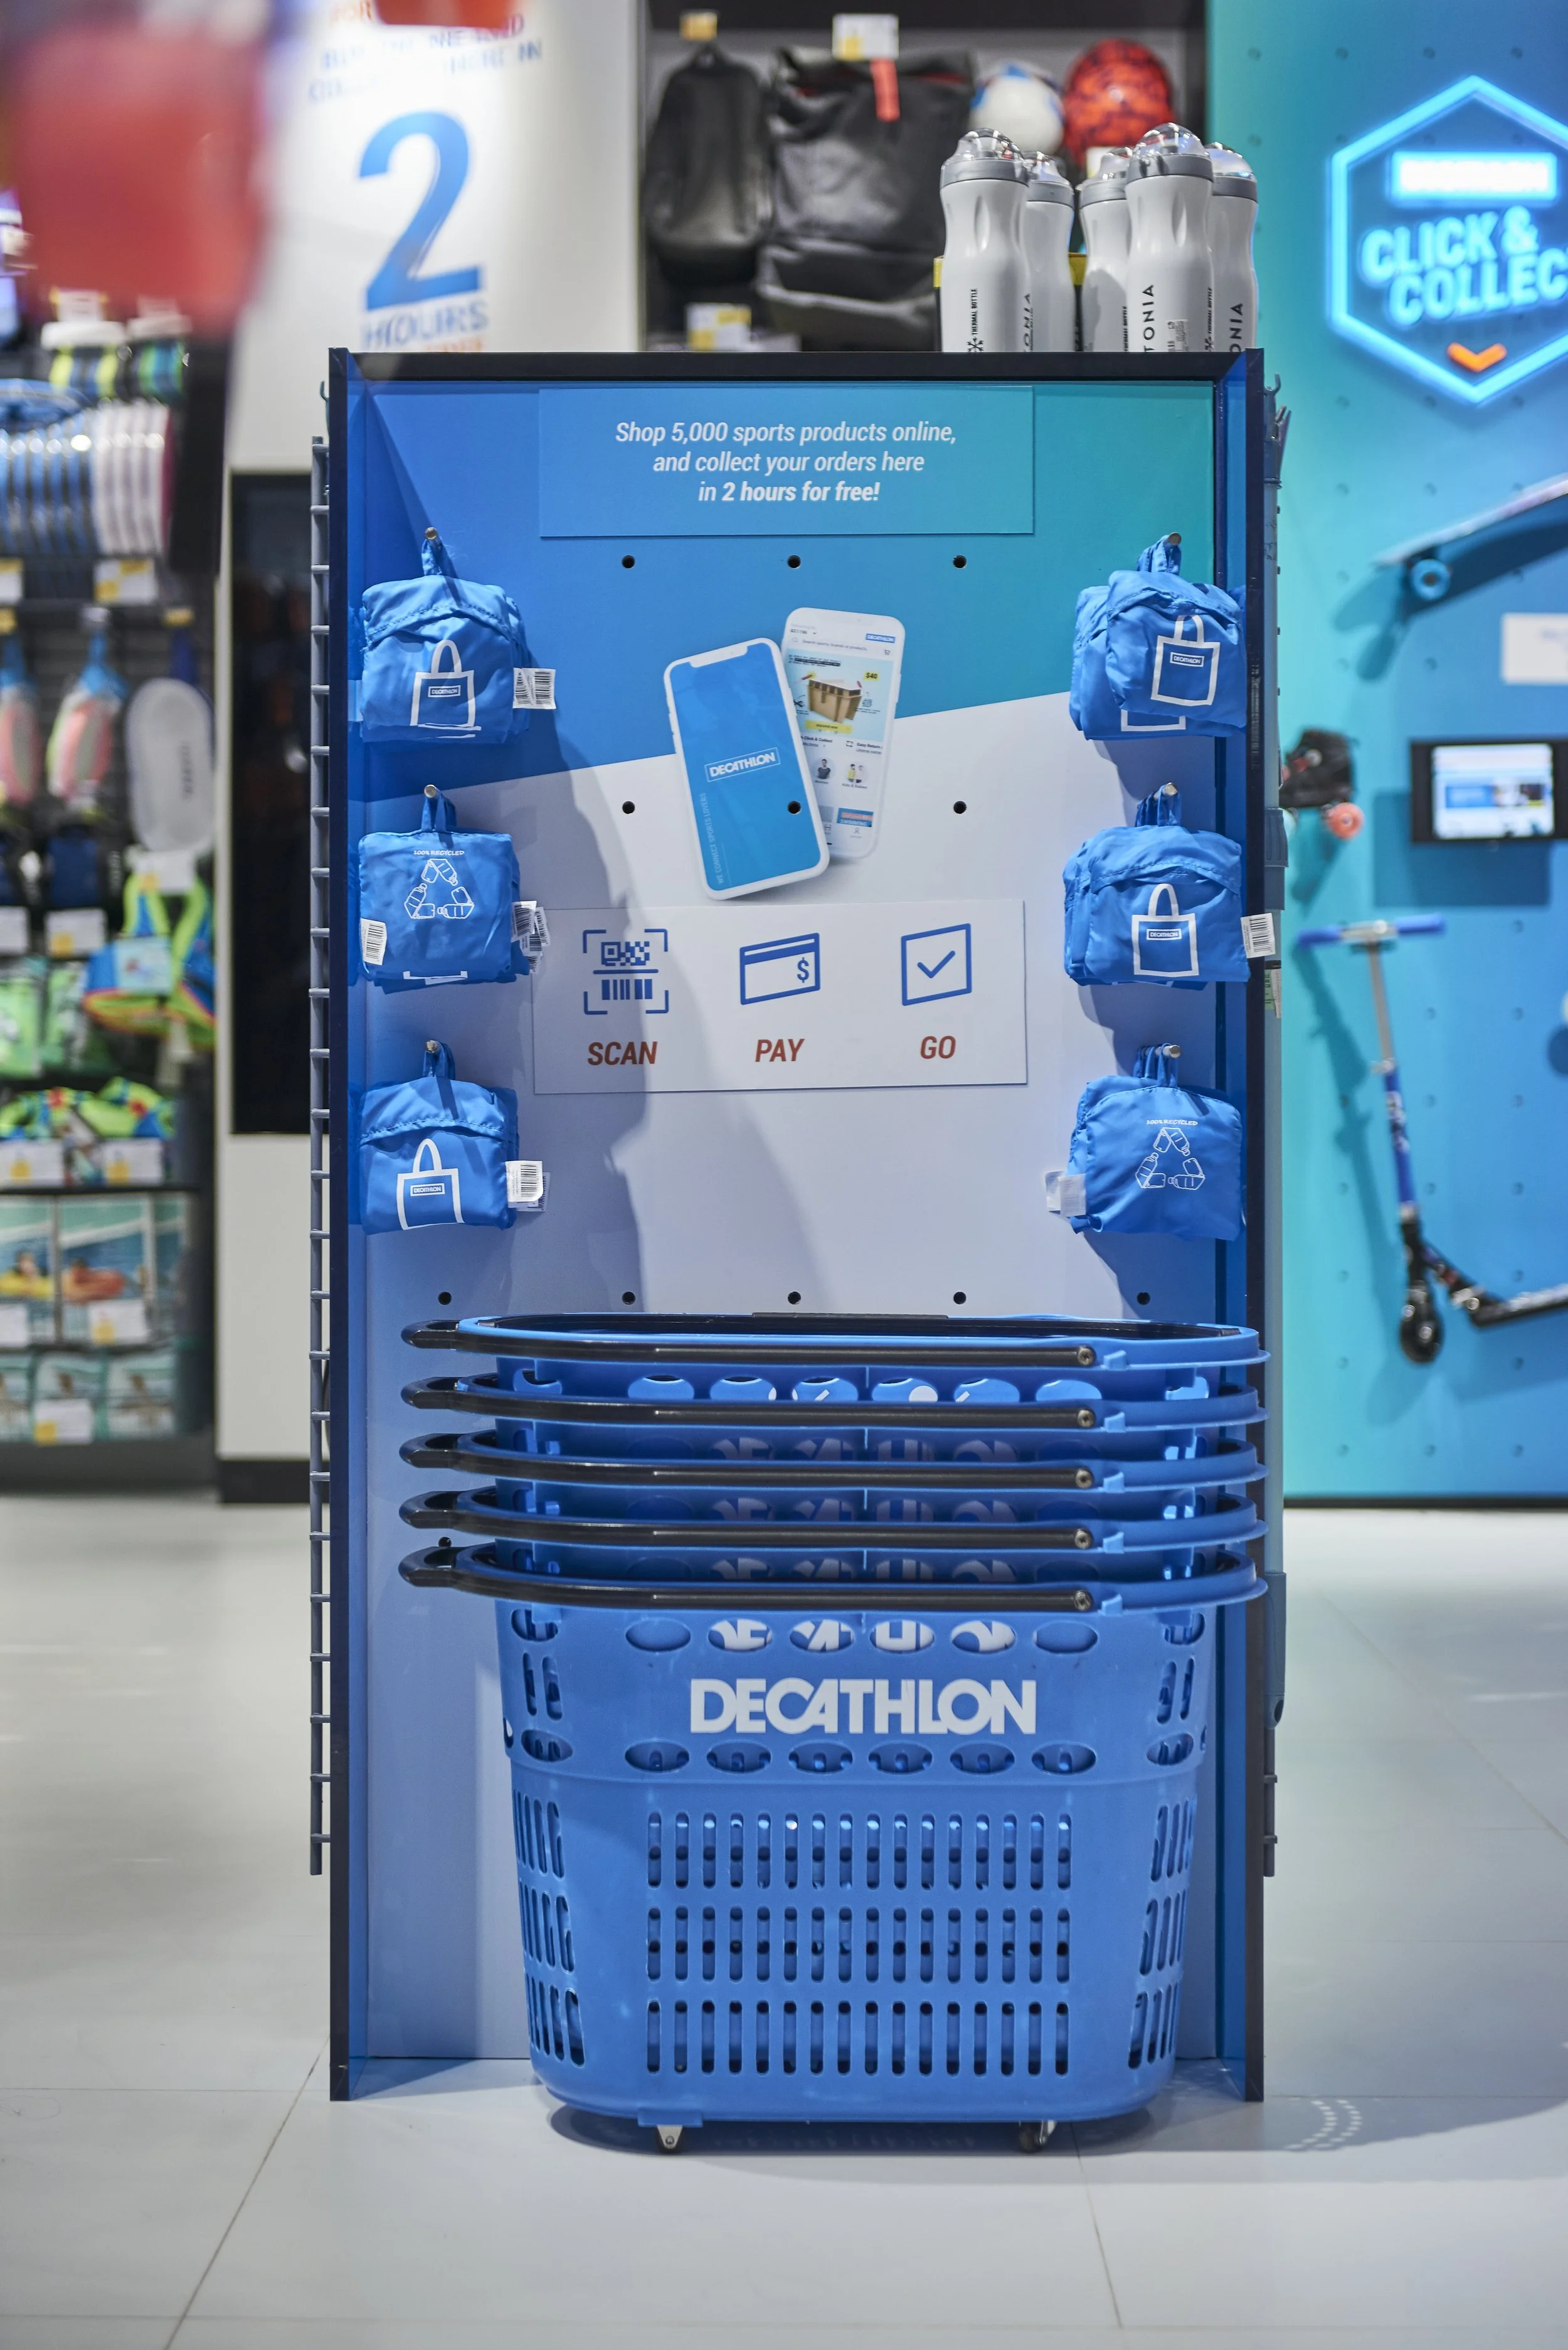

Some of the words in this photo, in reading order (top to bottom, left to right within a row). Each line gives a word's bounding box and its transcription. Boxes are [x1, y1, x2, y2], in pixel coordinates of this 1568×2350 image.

[359, 110, 480, 311] 2
[1362, 211, 1499, 281] CLICK
[1502, 206, 1539, 255] &
[1389, 246, 1568, 326] COLLEC
[363, 300, 488, 349] HOURS
[616, 422, 665, 446] Shop
[672, 422, 728, 444] 5,000
[733, 423, 795, 446] sports
[799, 421, 886, 446] products
[892, 421, 956, 444] online,
[654, 450, 691, 472] and
[696, 450, 760, 472] collect
[765, 455, 809, 476] your
[815, 450, 876, 472] orders
[882, 450, 924, 472] here
[698, 481, 716, 501] in
[722, 482, 736, 501] 2
[741, 481, 796, 501] hours
[802, 481, 830, 501] for
[835, 481, 881, 501] free!
[1173, 656, 1201, 664] DECATHLON
[709, 752, 776, 777] DECATHLON
[587, 1041, 657, 1066] SCAN
[755, 1038, 805, 1063] PAY
[919, 1035, 956, 1060] GO
[691, 1677, 1036, 1735] DECATHLON
